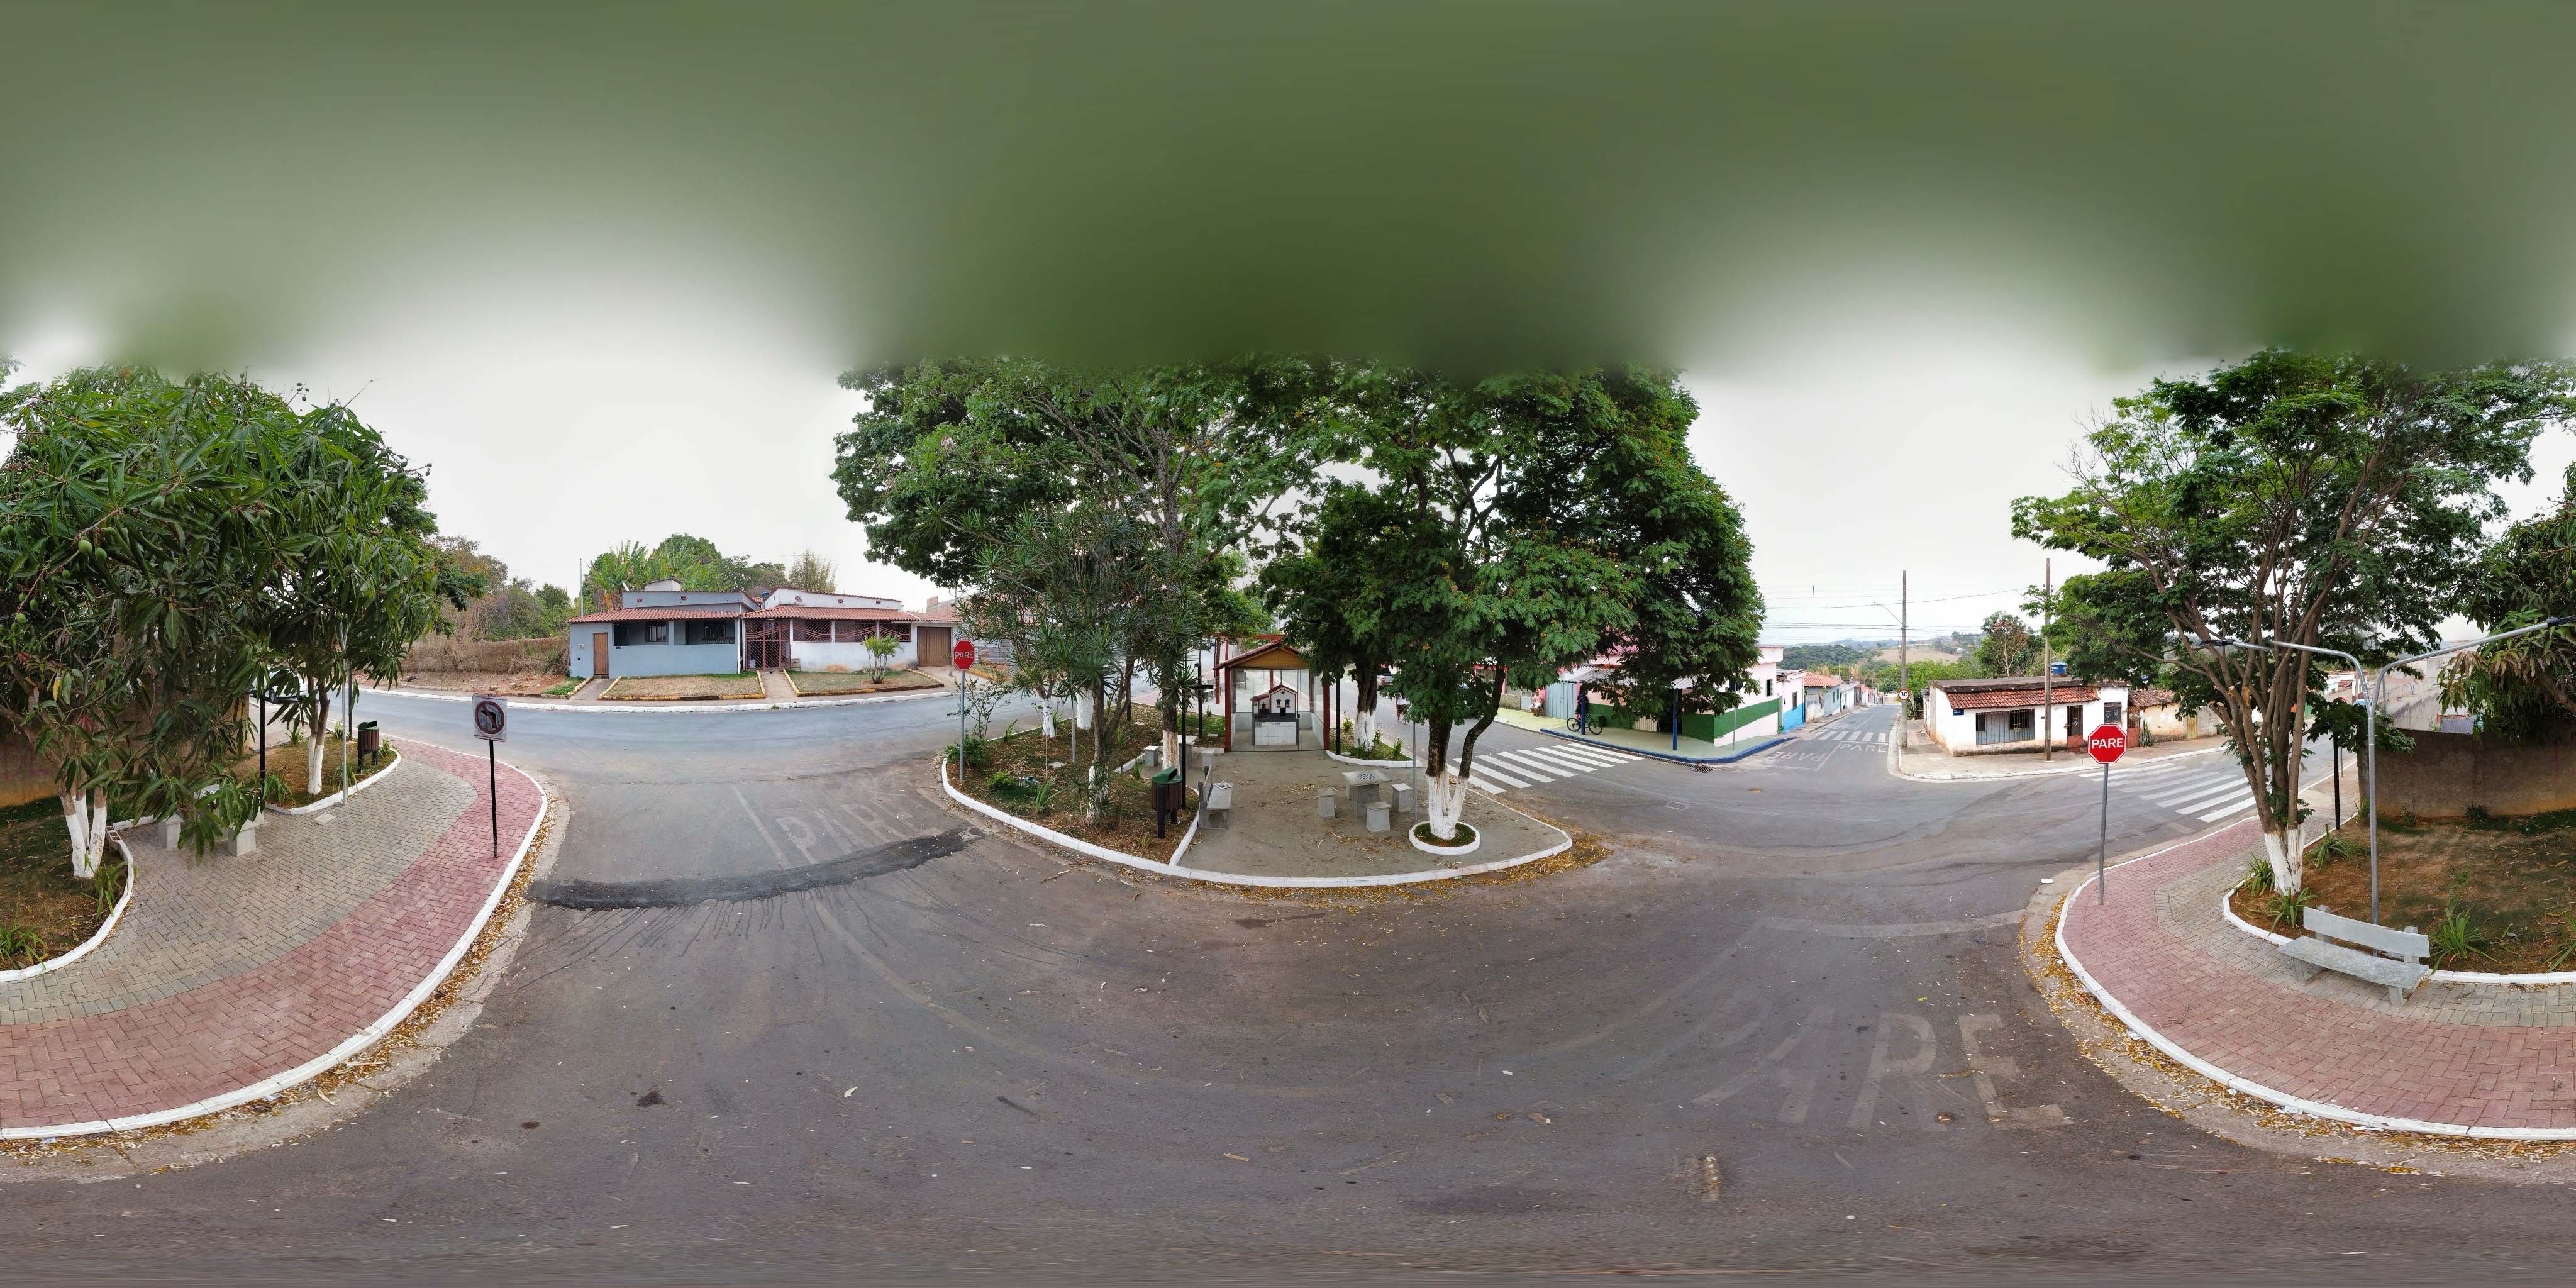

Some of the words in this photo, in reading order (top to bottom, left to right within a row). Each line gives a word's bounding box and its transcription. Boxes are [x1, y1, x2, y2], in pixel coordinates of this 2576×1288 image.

[955, 651, 974, 659] PARE
[1839, 743, 1887, 752] PARE
[2091, 738, 2124, 749] PARE
[1765, 752, 1825, 762] PARE
[775, 797, 943, 865] PARE
